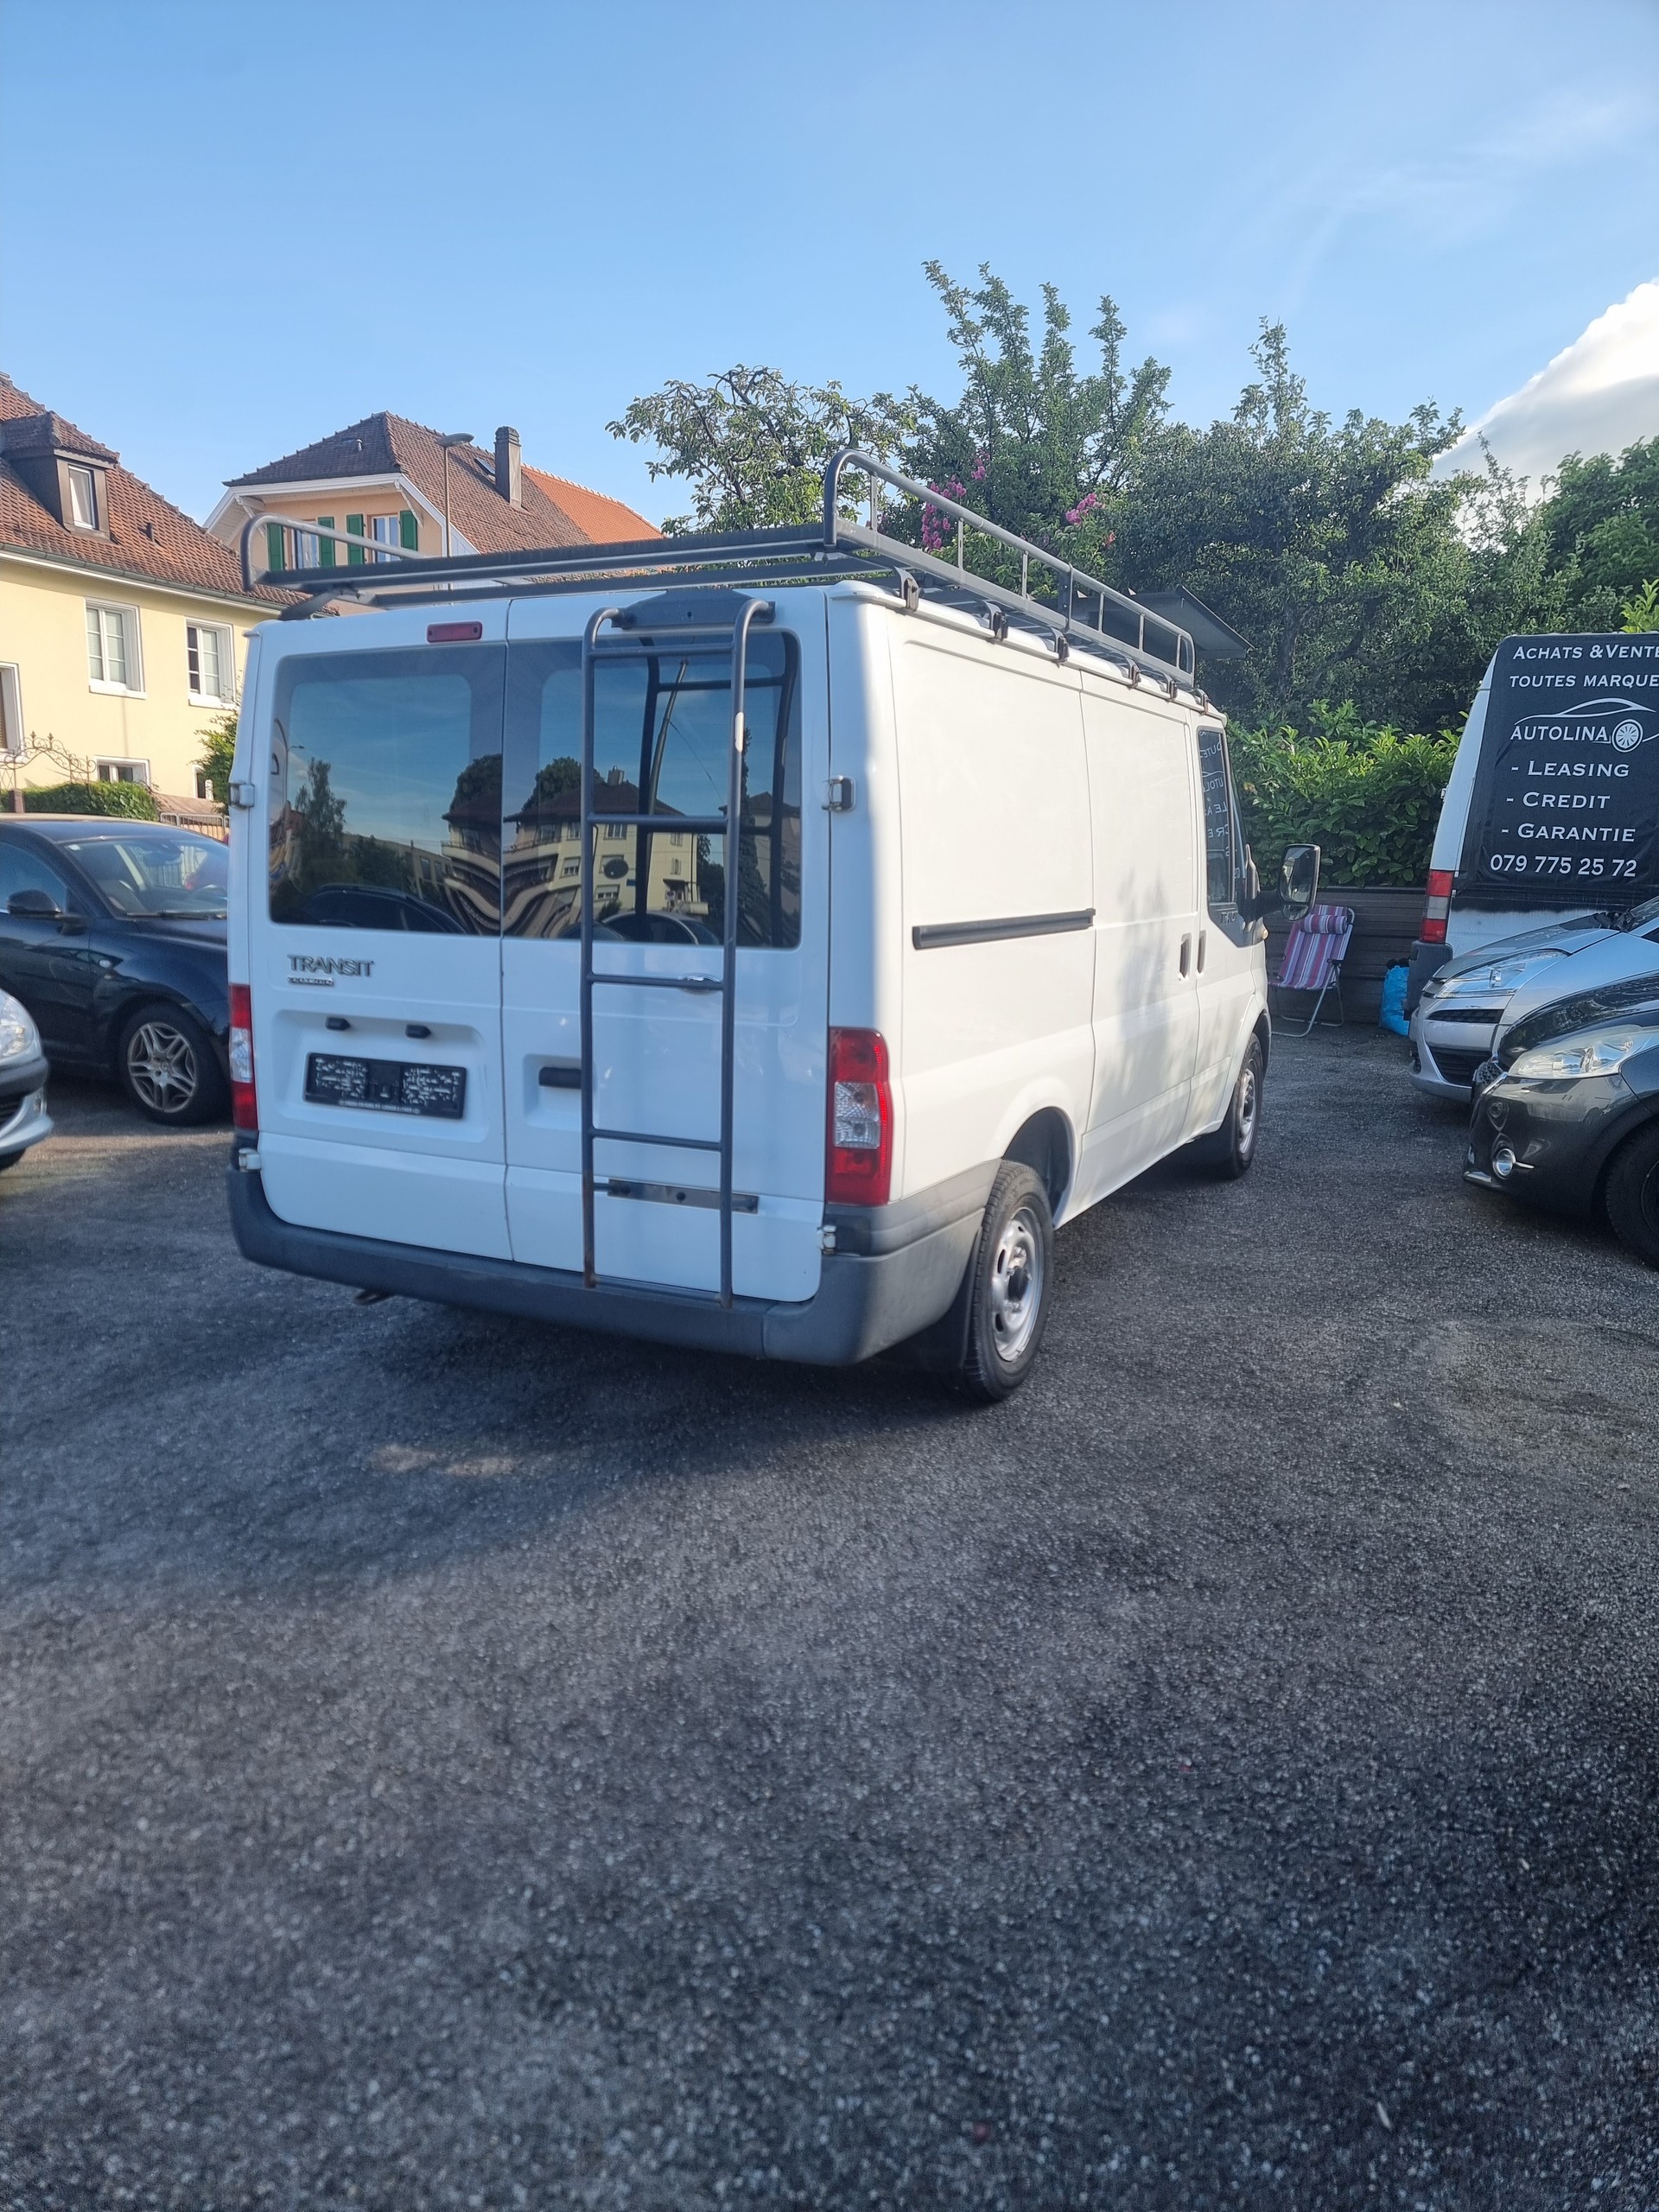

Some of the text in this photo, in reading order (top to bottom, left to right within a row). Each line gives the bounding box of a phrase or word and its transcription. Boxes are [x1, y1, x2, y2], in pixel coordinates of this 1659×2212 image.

[1512, 645, 1584, 660] ACHATS
[1509, 674, 1659, 690] TOUTES MARQUE
[1509, 725, 1609, 741] AUTOLINA
[1527, 760, 1630, 778] LEASING
[1522, 791, 1611, 810] CREDIT
[1516, 823, 1637, 843] GARANTIE
[1490, 853, 1637, 878] 079 775 25 72
[286, 953, 375, 978] TRANSIT
